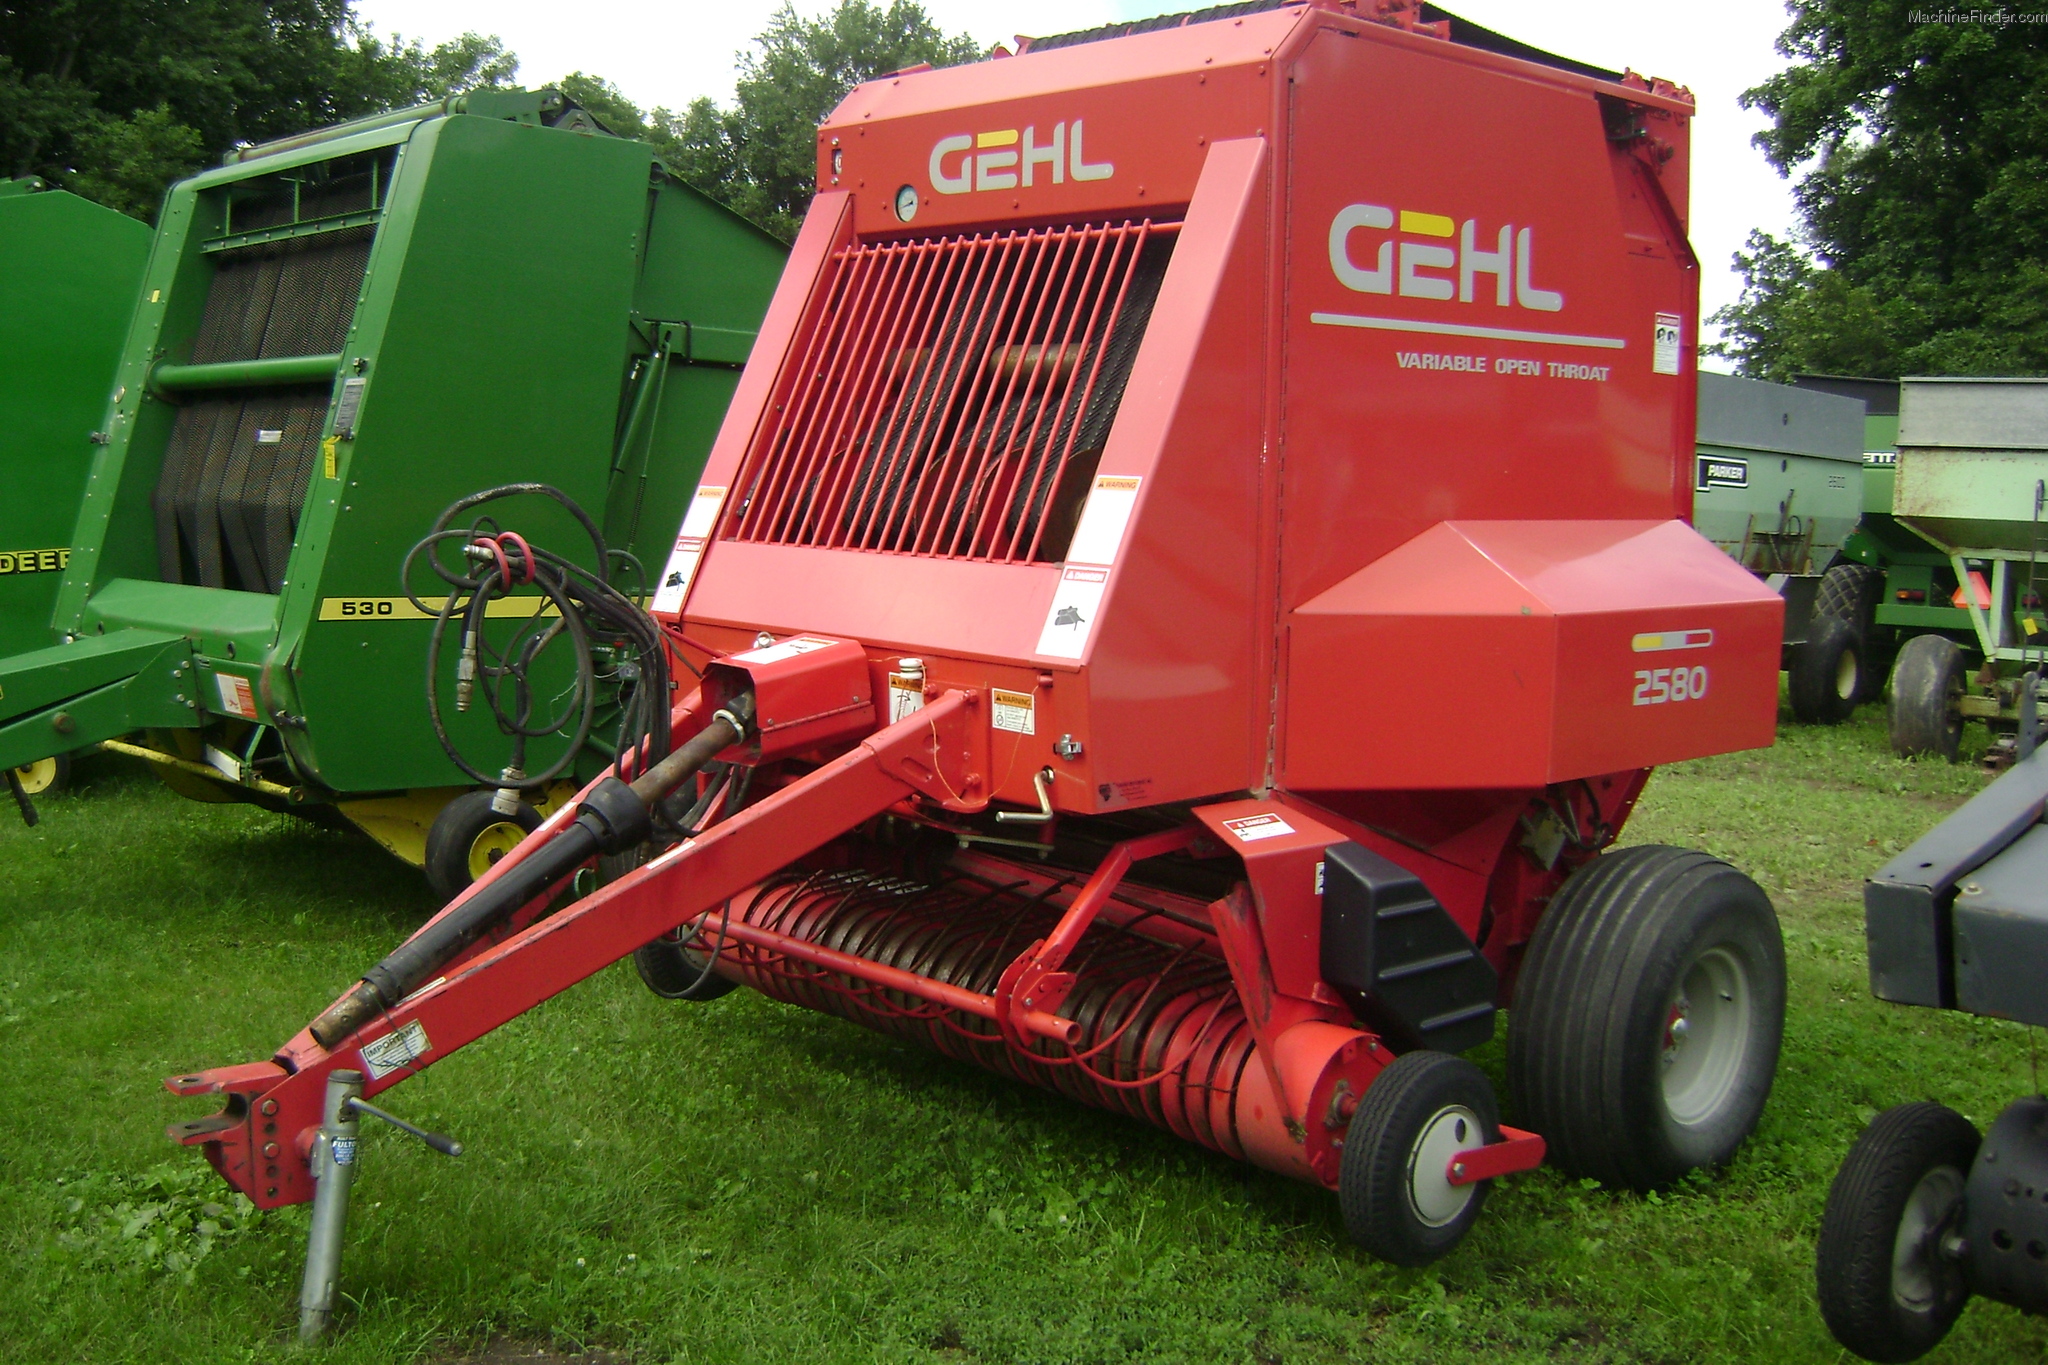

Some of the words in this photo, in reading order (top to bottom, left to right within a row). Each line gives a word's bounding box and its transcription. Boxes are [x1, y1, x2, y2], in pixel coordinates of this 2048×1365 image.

[928, 119, 1114, 195] GEHL
[1328, 203, 1563, 312] GEHL
[1396, 352, 1487, 373] VARIABLE
[1494, 358, 1541, 376] OPEN
[1547, 362, 1610, 382] THROAT
[1707, 464, 1744, 480] PARKER
[342, 601, 393, 616] 530
[1002, 695, 1031, 707] WARNING
[1632, 665, 1707, 706] 2580
[366, 1025, 417, 1058] IMPORTANT
